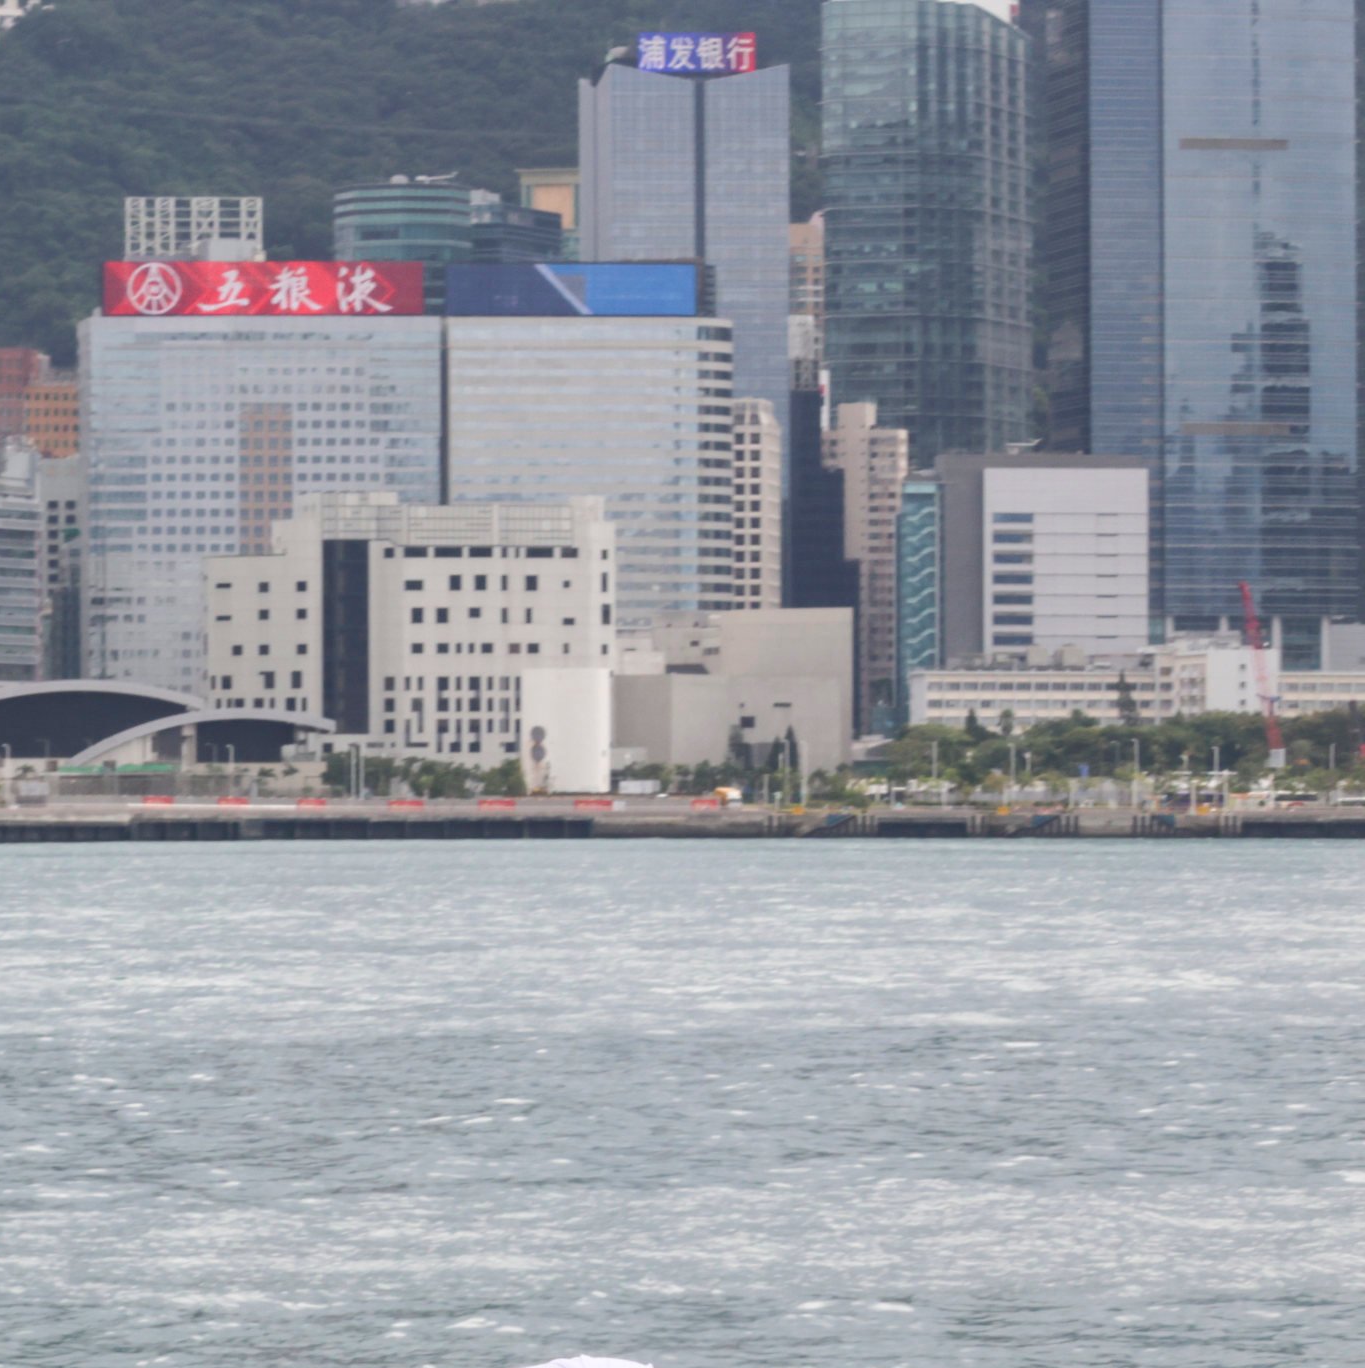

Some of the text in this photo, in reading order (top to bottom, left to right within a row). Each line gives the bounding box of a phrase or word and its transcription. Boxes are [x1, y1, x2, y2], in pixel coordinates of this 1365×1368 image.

[638, 35, 755, 70] 浦发银行
[198, 265, 394, 312] 五粮液
